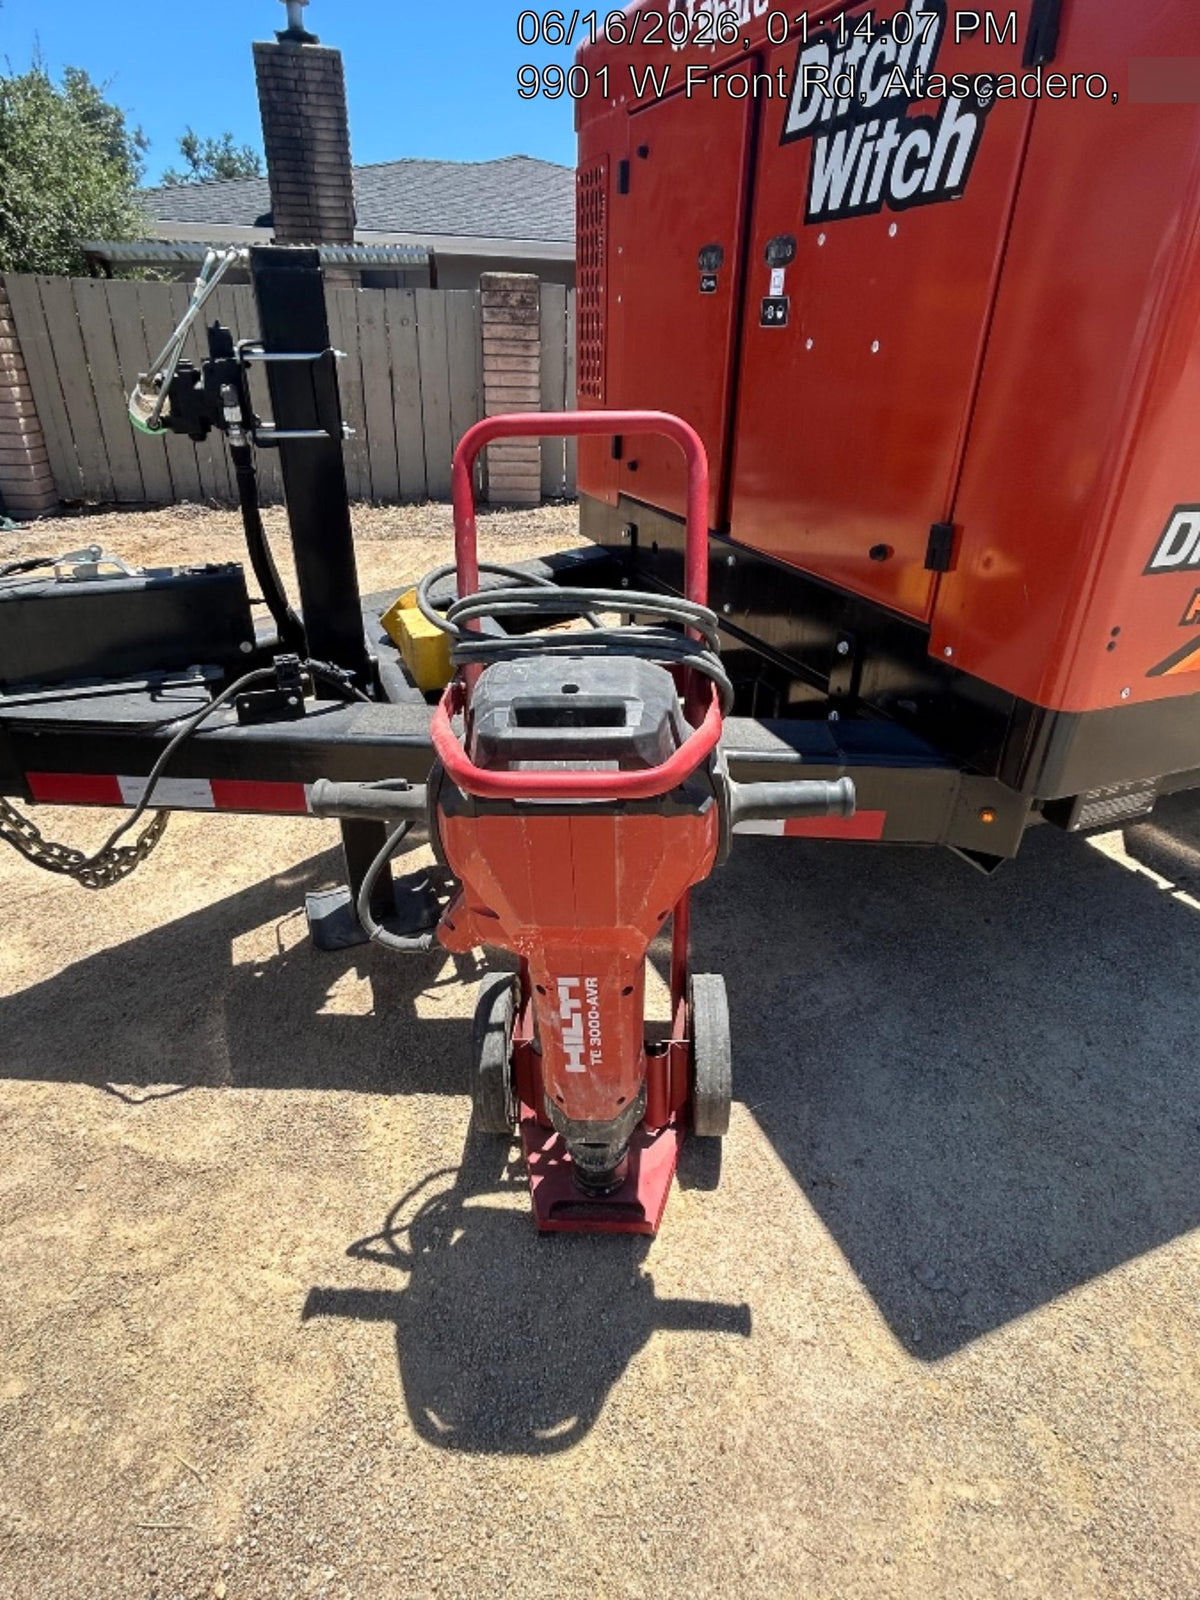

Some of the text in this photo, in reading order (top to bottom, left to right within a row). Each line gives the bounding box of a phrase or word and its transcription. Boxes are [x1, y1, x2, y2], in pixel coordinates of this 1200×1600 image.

[785, 0, 941, 134] Ditch
[809, 92, 977, 214] Witch
[557, 977, 586, 1072] HILTI
[585, 977, 601, 1045] 3000-AVR
